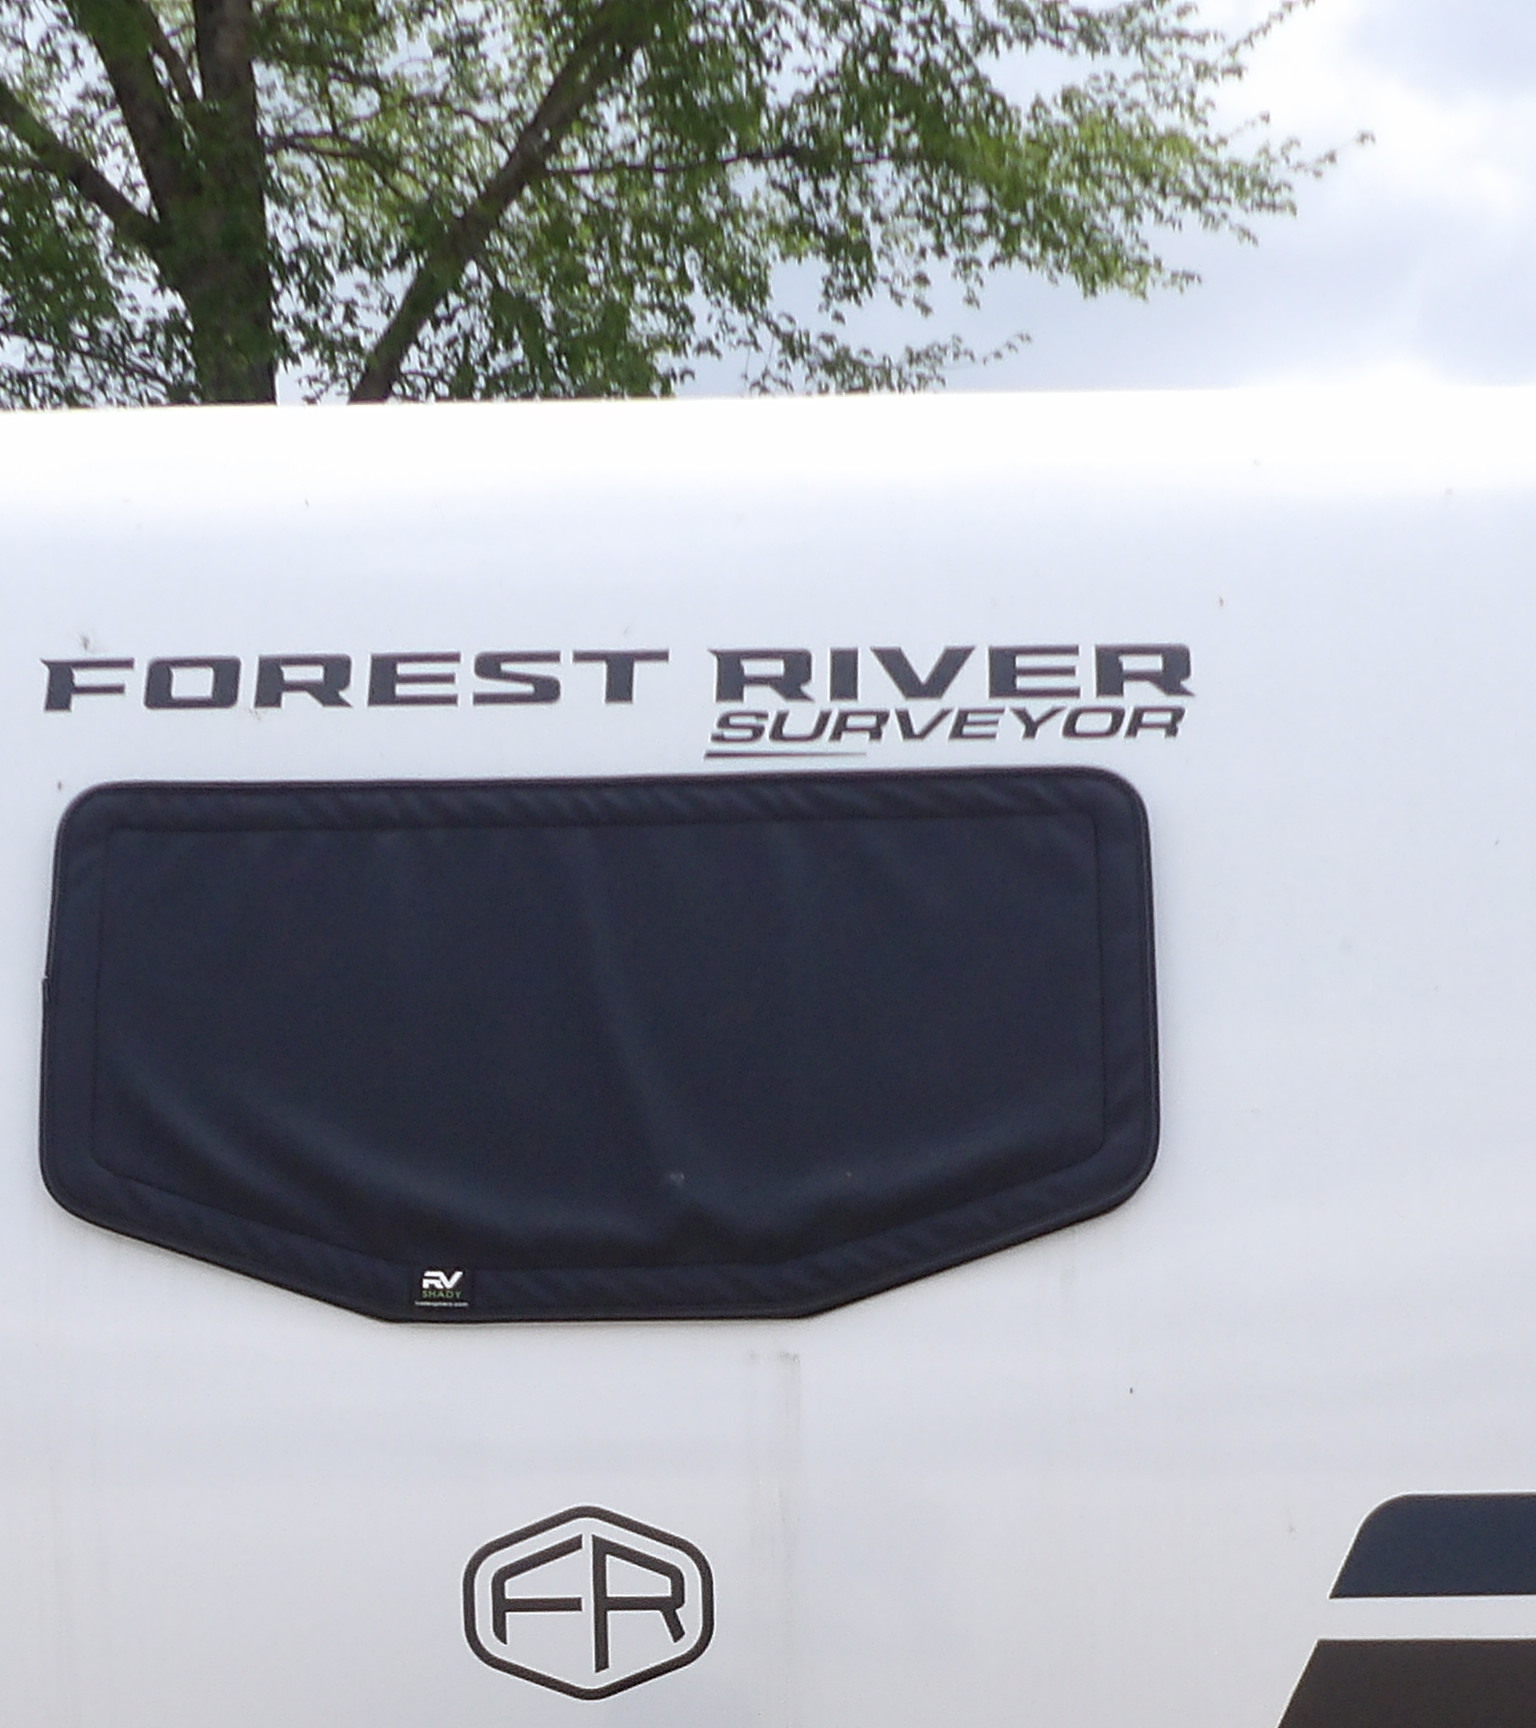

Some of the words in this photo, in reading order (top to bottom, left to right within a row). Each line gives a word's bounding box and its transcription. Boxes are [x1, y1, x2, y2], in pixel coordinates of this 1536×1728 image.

[39, 648, 670, 712] FOREST
[707, 643, 1196, 703] RIVER
[710, 705, 1187, 744] SURVEYOR
[422, 1271, 464, 1289] RV
